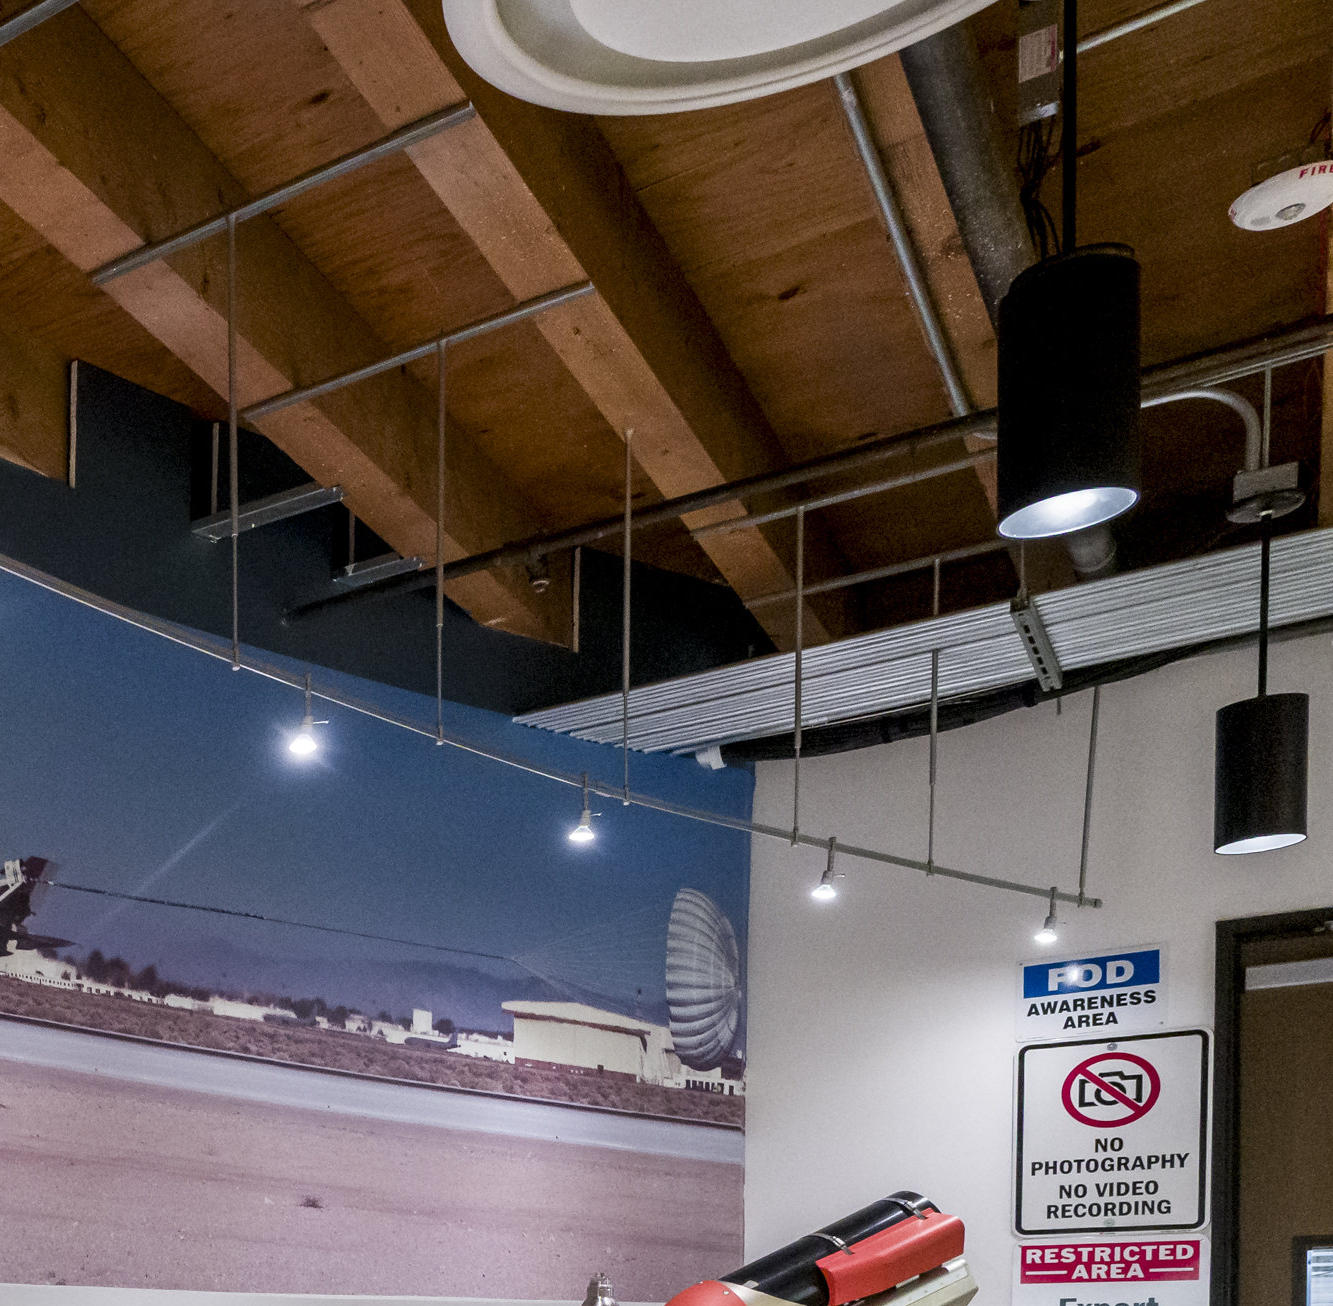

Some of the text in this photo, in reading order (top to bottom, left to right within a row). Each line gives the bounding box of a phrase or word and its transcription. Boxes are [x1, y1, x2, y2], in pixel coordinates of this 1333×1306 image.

[1048, 960, 1134, 991] FOD
[1027, 990, 1156, 1017] AWARENESS
[1063, 1012, 1118, 1030] AREA
[1094, 1137, 1123, 1152] NO
[1031, 1152, 1190, 1176] PHOTOGRAPHY
[1058, 1180, 1159, 1199] NO VIDEO
[1046, 1199, 1172, 1219] RECORDING
[1025, 1244, 1194, 1264] RESTRICTED
[1071, 1263, 1145, 1280] AREA
